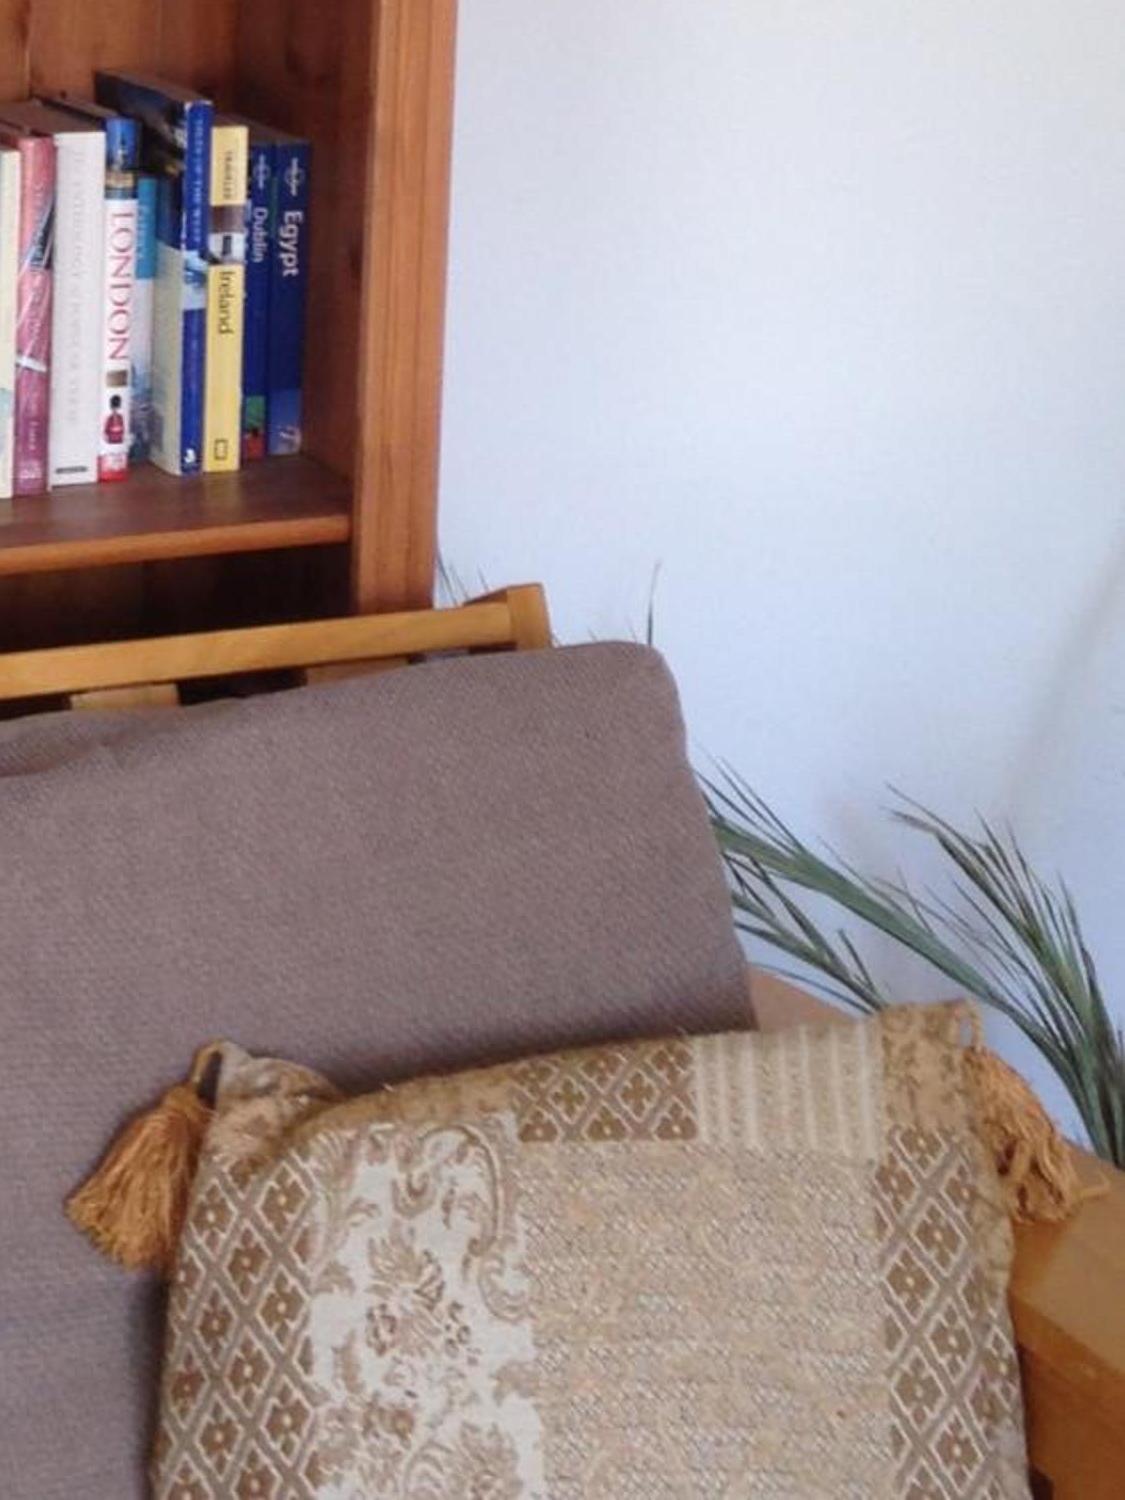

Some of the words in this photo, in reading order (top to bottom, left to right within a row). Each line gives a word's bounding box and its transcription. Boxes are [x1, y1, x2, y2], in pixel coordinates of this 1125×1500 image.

[252, 206, 270, 263] Dublin
[280, 210, 303, 277] Egypt
[106, 211, 134, 361] LONDON
[218, 269, 236, 335] Ireland
